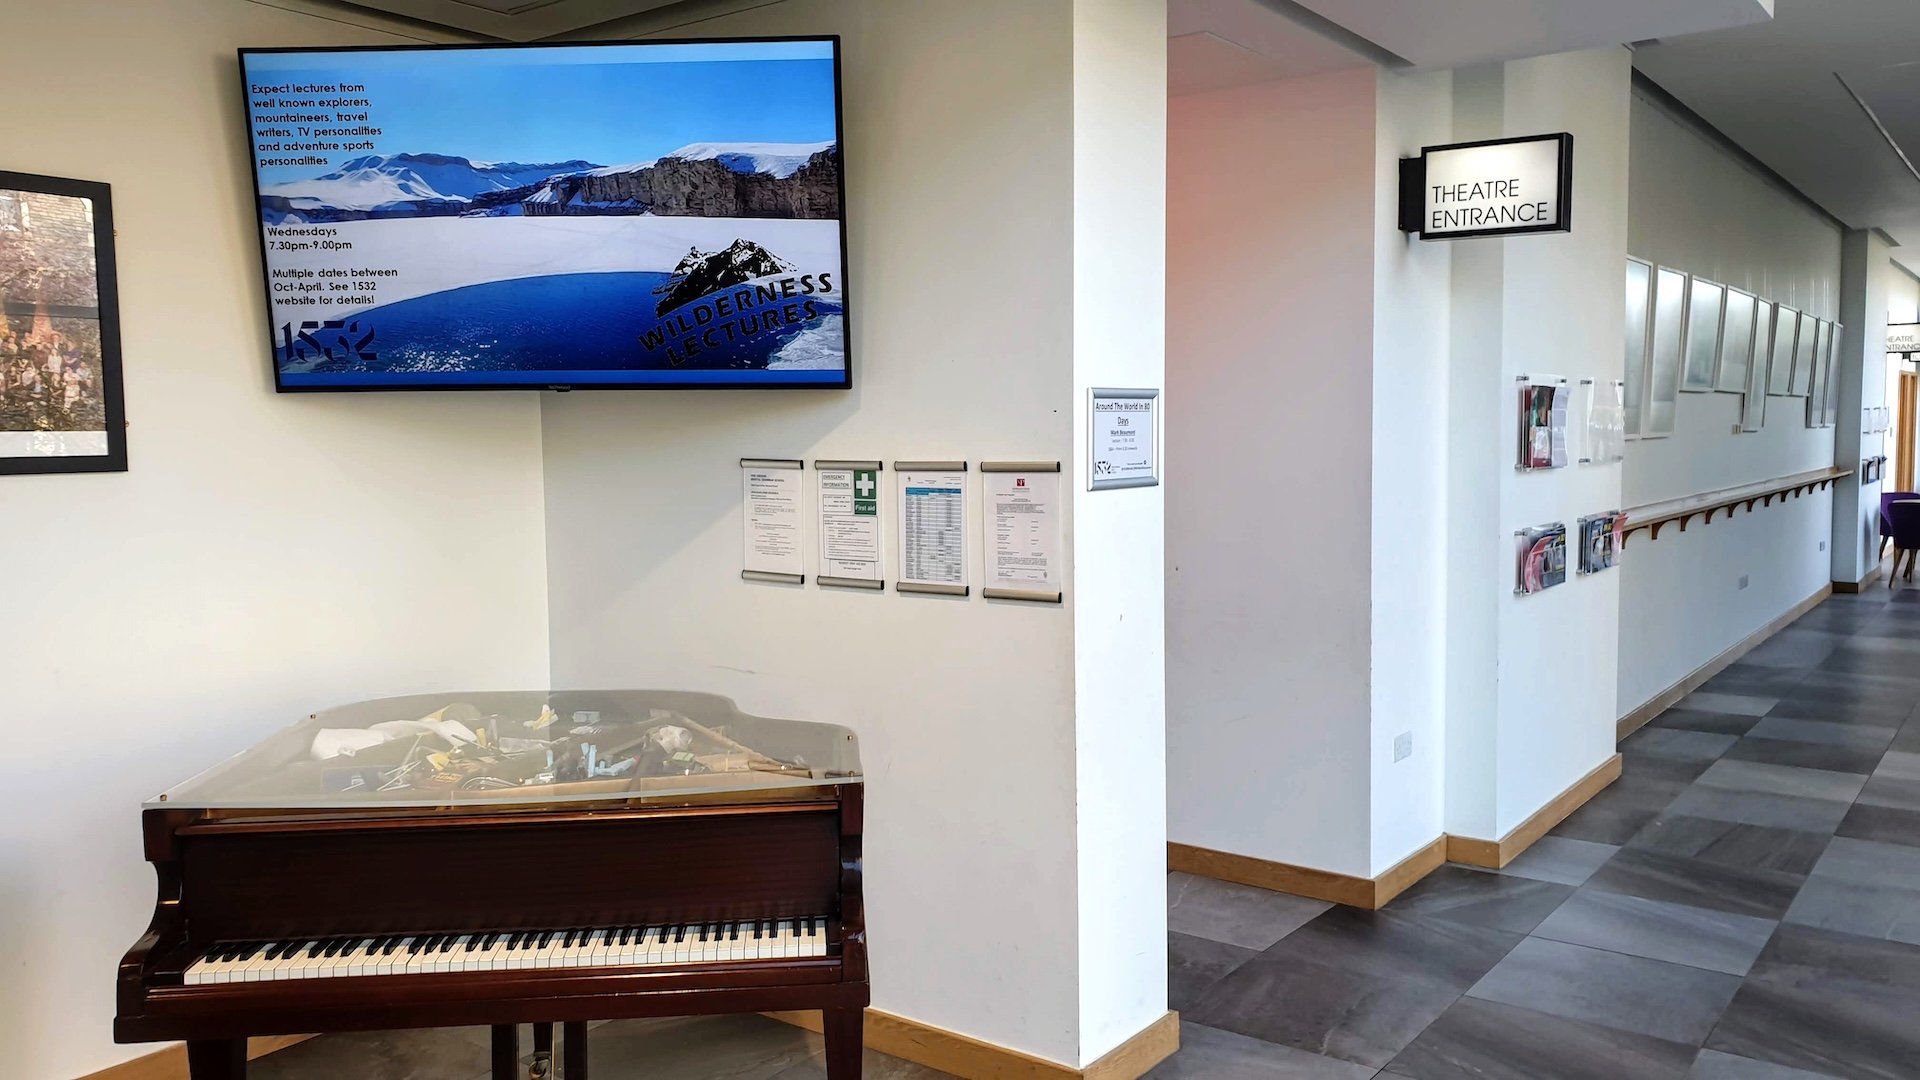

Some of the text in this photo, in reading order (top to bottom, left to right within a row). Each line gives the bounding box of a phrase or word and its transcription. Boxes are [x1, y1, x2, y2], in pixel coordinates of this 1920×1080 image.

[251, 83, 364, 95] Expect lectures from
[253, 97, 372, 108] well known explorers,
[255, 112, 368, 123] mountaineers, travel
[256, 126, 382, 138] writers, TV personalities
[258, 140, 374, 152] and adventure sports
[260, 156, 328, 167] personalities
[1432, 179, 1519, 203] THEATRE
[1432, 202, 1547, 228] ENTRANCE
[267, 226, 337, 238] Wednesdays
[269, 240, 352, 252] 7.30pm-9.00pm
[272, 267, 398, 279] Multiple dates between
[273, 281, 377, 293] Oct-April. See 1532
[275, 294, 375, 306] website for details!
[638, 272, 833, 352] WILDERNESS
[664, 300, 819, 367] LECTURES
[1887, 335, 1914, 343] HEATRE
[281, 320, 378, 362] 1532
[1886, 343, 1920, 351] NTRANC
[1096, 402, 1113, 411] Around
[1114, 402, 1123, 411] The
[1124, 402, 1138, 411] World
[1144, 402, 1150, 411] 80
[1117, 416, 1129, 426] Days
[855, 504, 867, 512] First
[867, 504, 876, 512] aid
